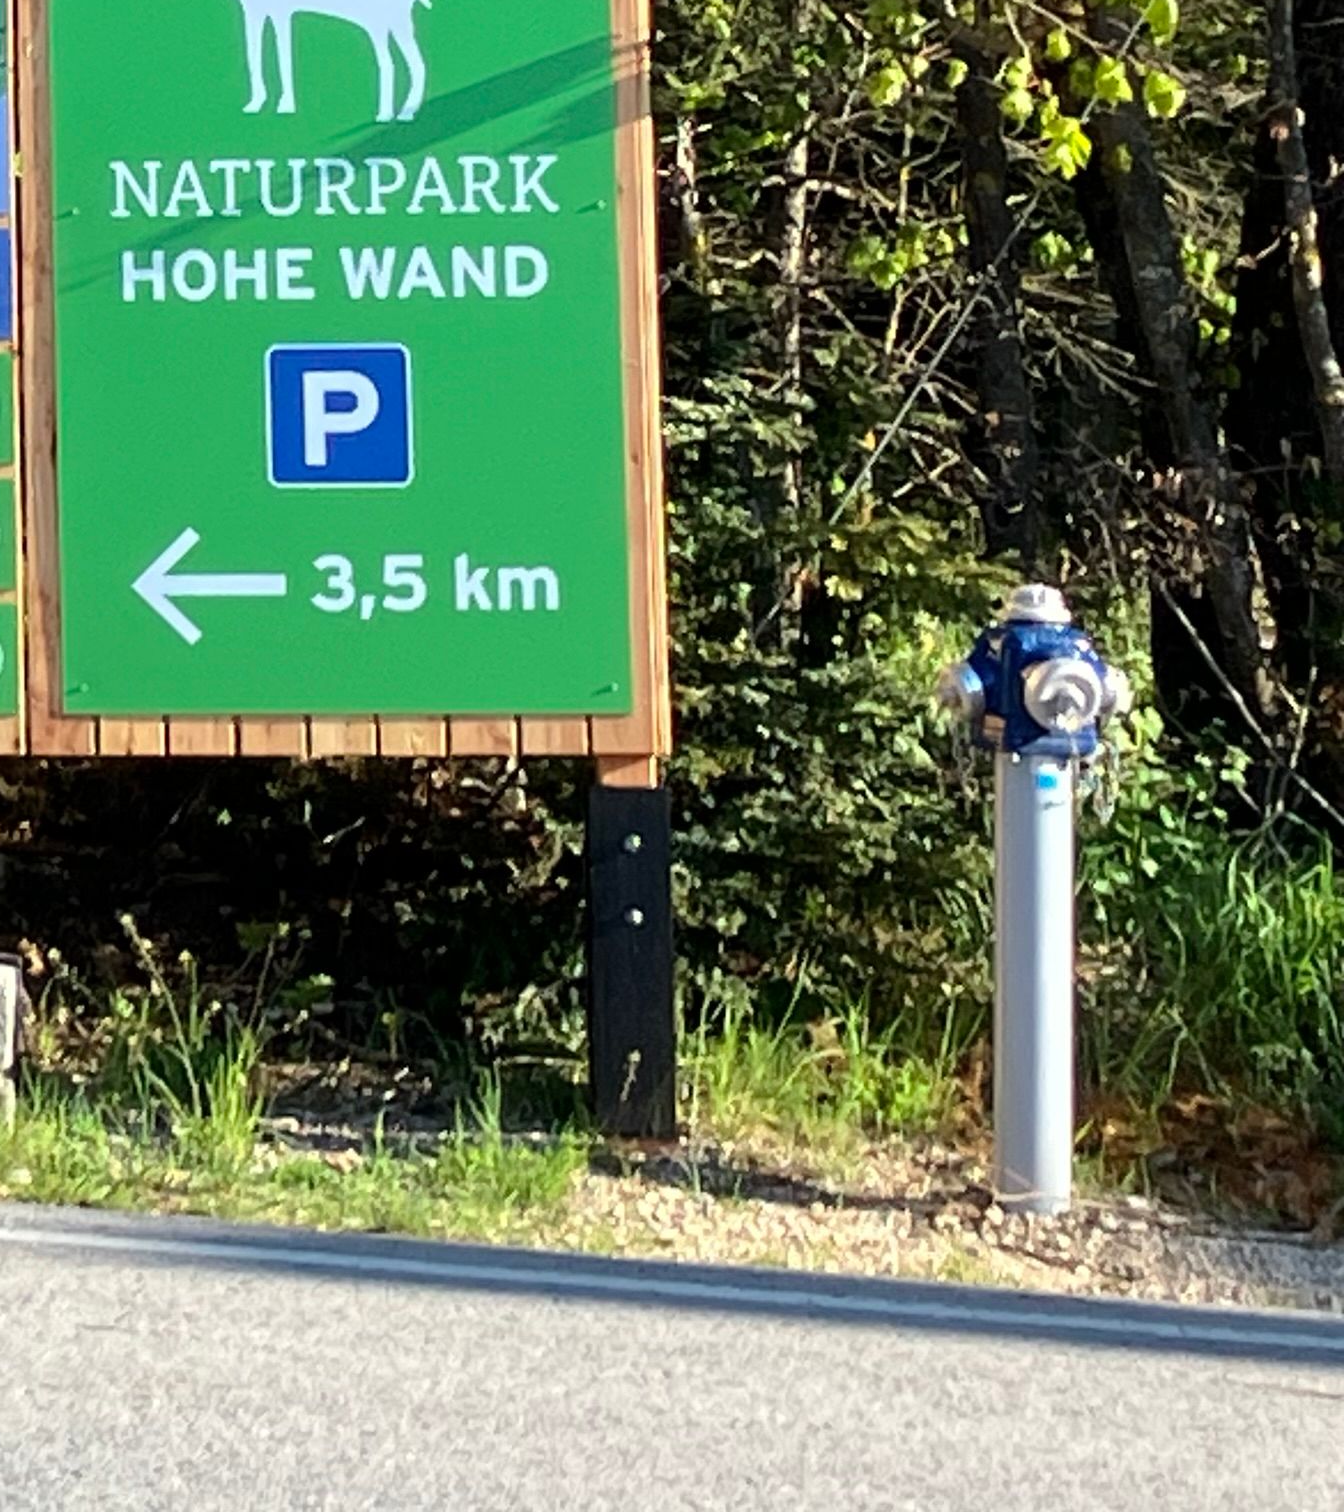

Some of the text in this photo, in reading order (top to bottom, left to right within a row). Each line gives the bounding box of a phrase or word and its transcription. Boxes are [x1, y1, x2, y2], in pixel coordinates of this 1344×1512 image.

[109, 154, 560, 219] NATURPARK
[121, 245, 549, 302] HOHE WAND
[302, 369, 381, 467] P
[311, 552, 560, 620] 3,5 km
